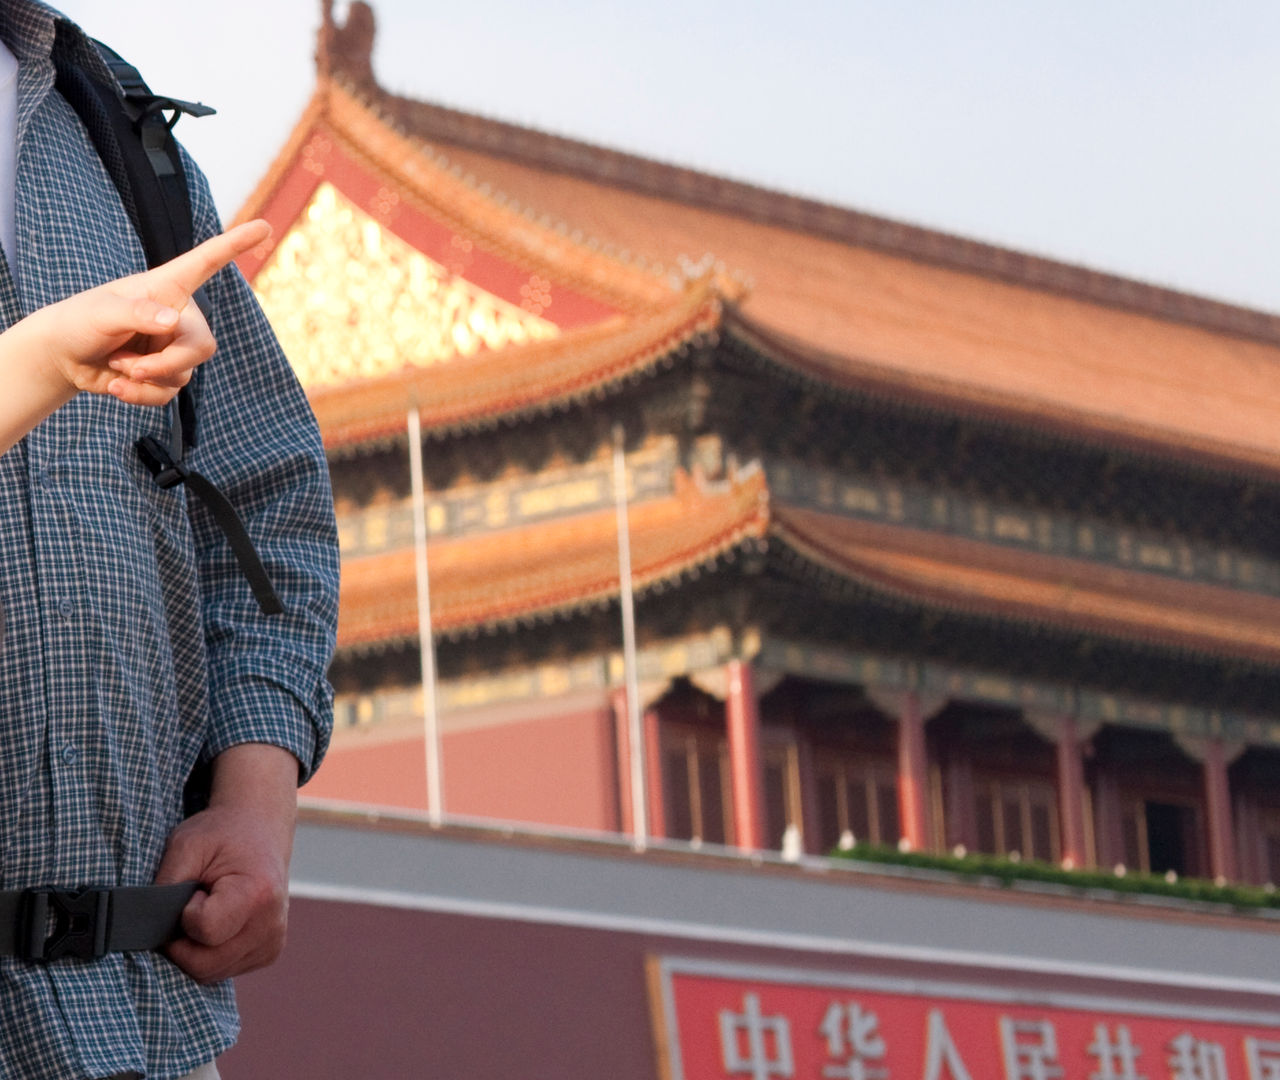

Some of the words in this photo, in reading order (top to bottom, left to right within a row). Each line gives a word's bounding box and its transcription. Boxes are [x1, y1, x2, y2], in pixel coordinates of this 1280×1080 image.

[719, 992, 1280, 1080] 中华人民共和
